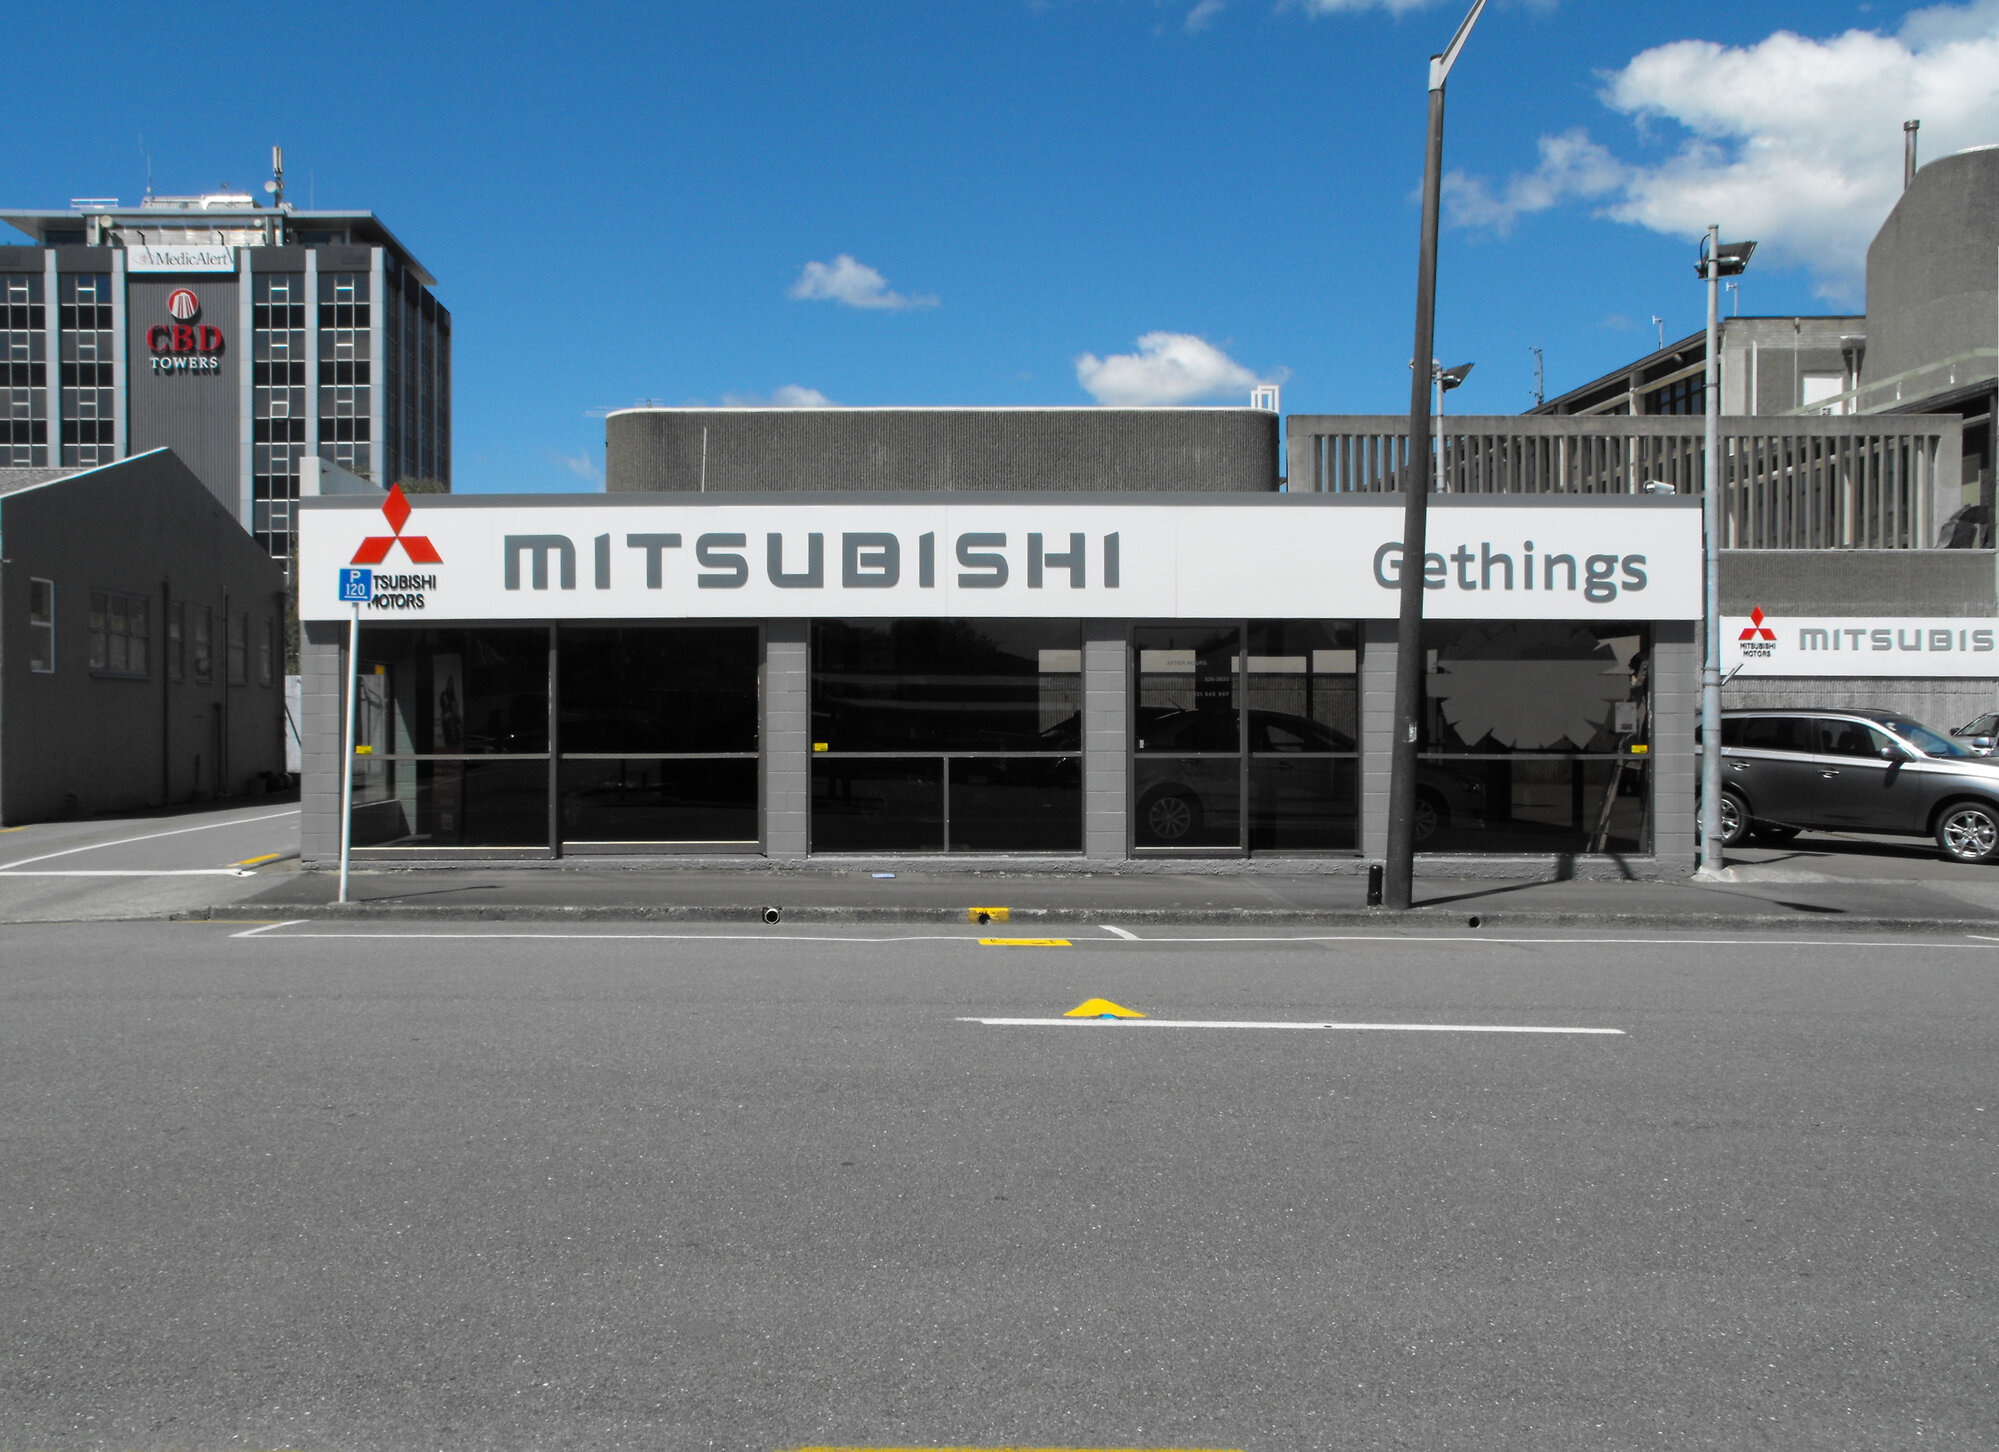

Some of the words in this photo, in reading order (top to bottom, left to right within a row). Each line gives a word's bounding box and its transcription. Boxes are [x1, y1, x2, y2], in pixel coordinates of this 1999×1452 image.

[156, 252, 229, 266] MedicAlert
[146, 324, 222, 352] CBD
[150, 356, 219, 369] TOWERS
[504, 531, 1120, 591] MITSUBISHI
[350, 570, 361, 583] P
[1373, 540, 1649, 604] Gethings
[346, 583, 365, 596] 120
[373, 575, 437, 591] TSUBISHI
[1740, 642, 1776, 650] MITSUBISHI
[1799, 628, 1994, 651] MITSUBIS
[1743, 650, 1771, 658] MOTORS
